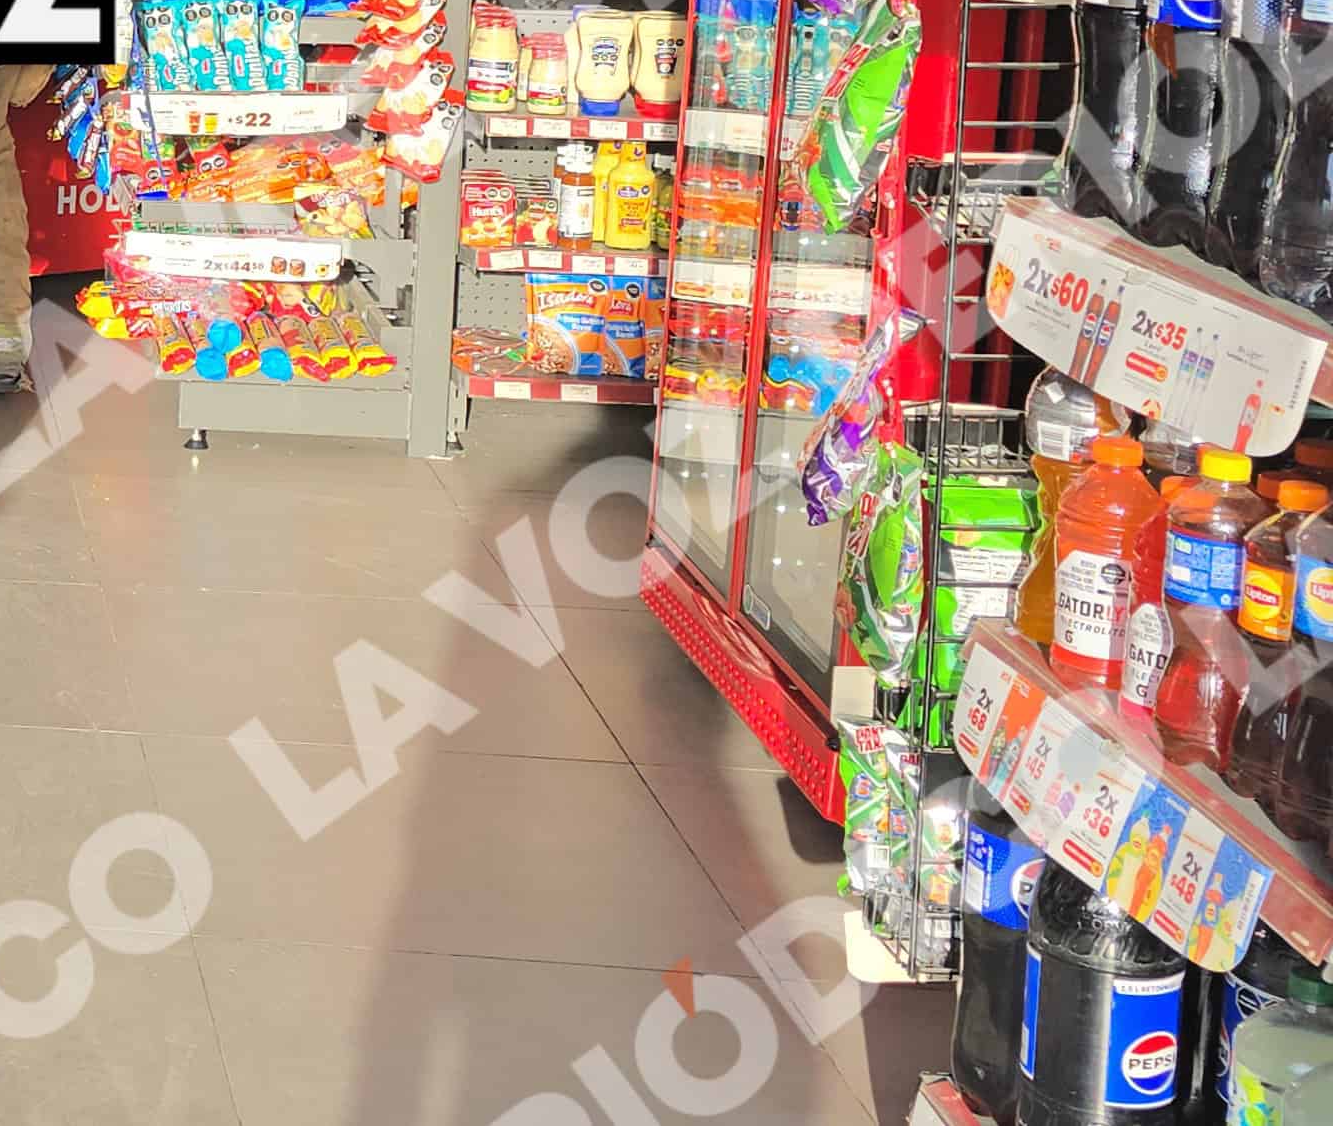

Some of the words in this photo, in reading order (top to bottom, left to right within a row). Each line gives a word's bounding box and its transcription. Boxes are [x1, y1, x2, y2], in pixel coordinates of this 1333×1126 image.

[235, 111, 272, 127] $22
[1022, 257, 1090, 314] 2x$60
[1132, 310, 1187, 352] 2x$35
[1245, 586, 1277, 605] Lipton
[1095, 785, 1120, 811] 2x
[1082, 807, 1110, 838] $36
[1181, 851, 1203, 878] 2x
[1169, 874, 1198, 905] $48
